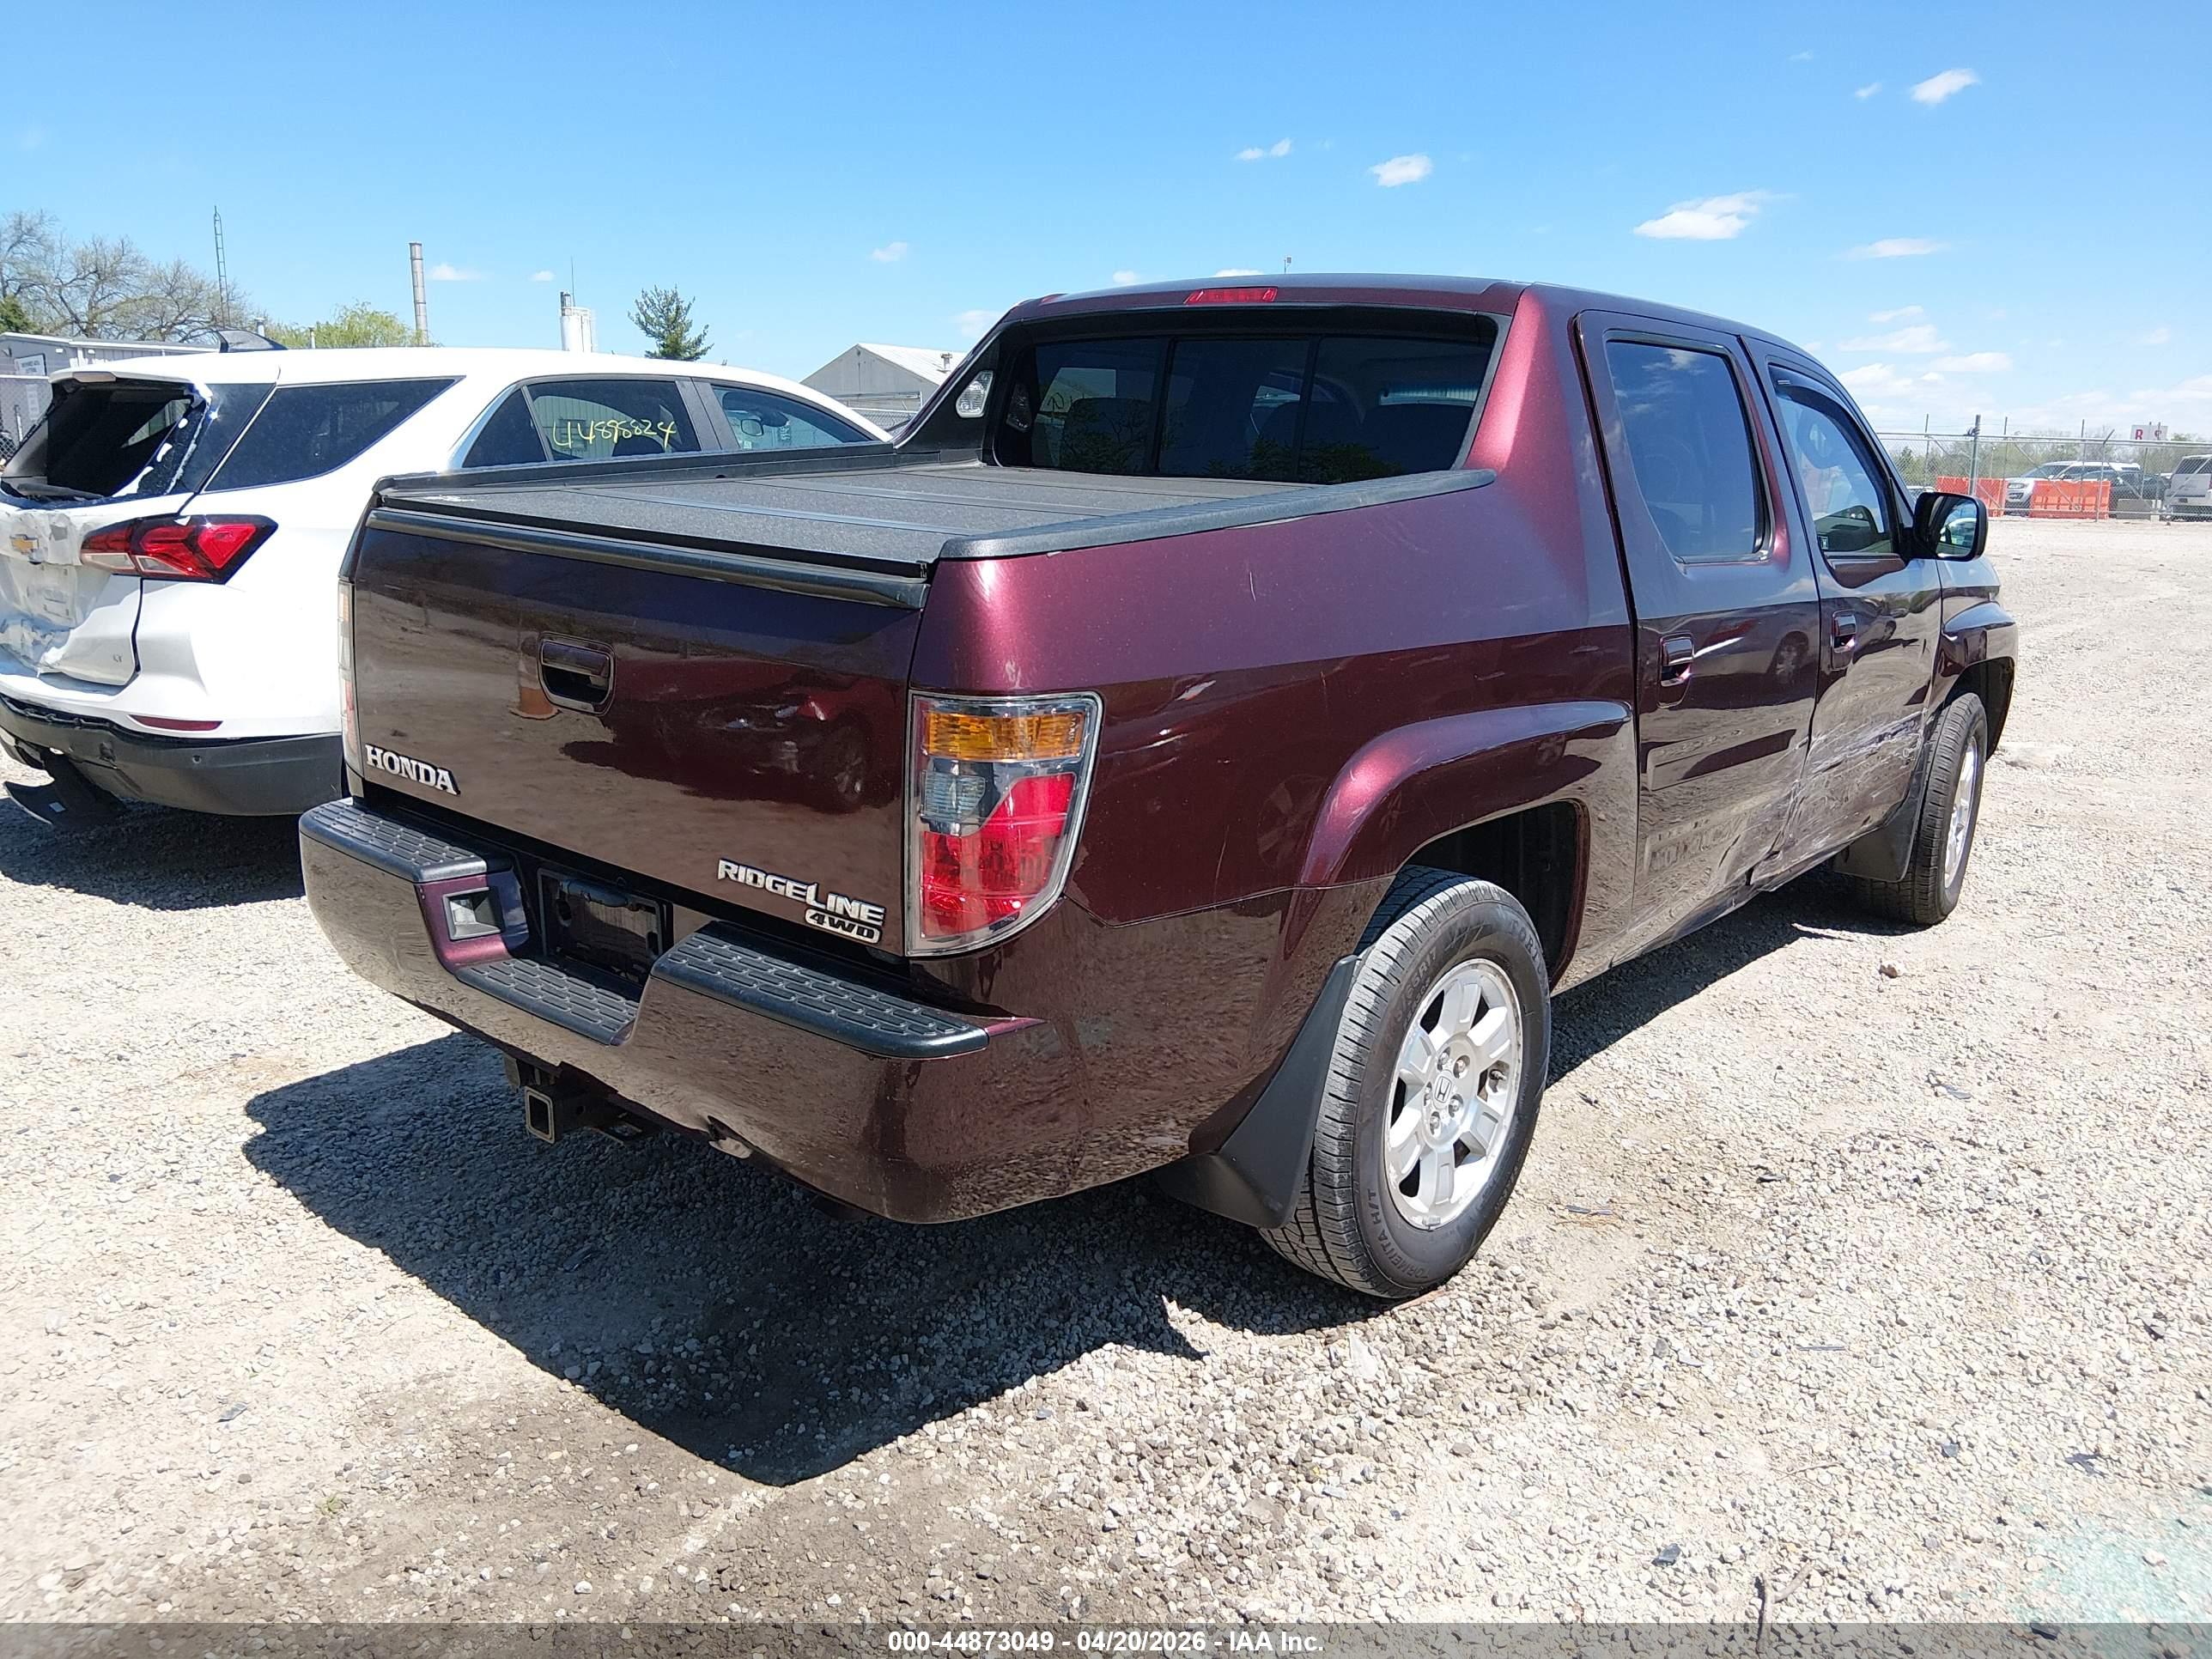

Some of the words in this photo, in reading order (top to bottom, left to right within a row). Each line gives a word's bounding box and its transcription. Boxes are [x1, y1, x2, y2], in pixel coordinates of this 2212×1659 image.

[365, 743, 459, 795] HONDA
[718, 859, 885, 927] RIDGELINE
[809, 912, 876, 940] 4WD
